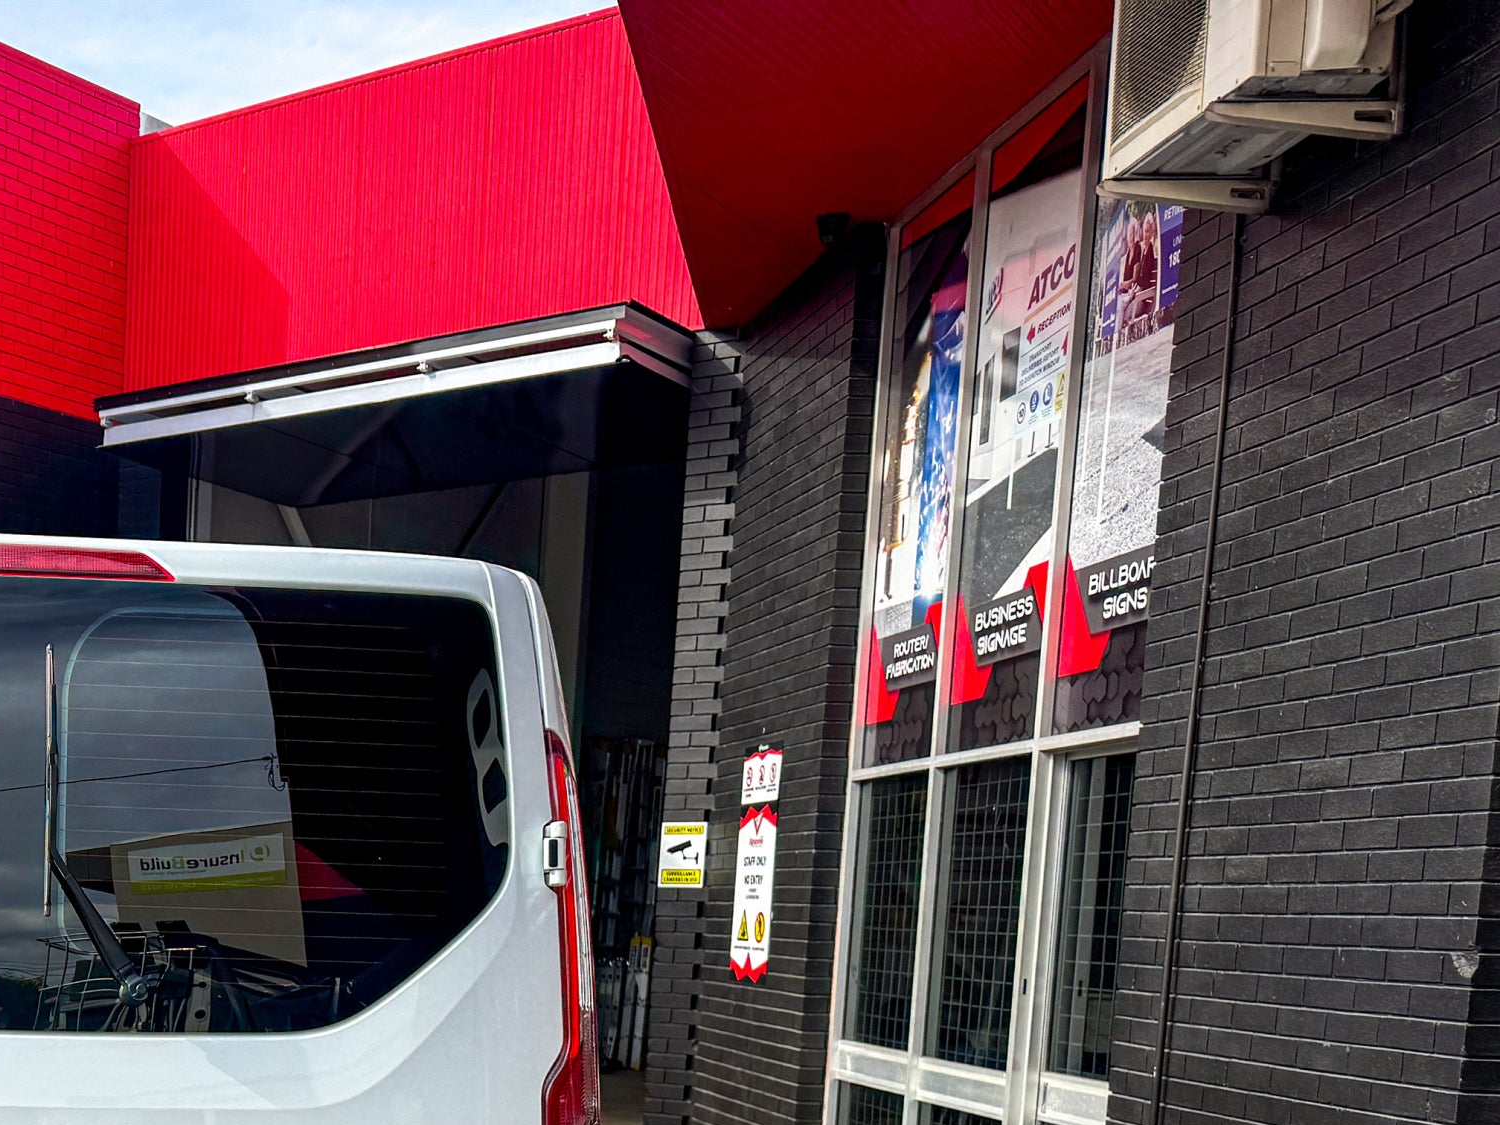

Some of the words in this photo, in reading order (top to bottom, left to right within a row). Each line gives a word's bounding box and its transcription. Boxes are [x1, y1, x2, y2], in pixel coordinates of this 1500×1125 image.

[1027, 243, 1077, 311] ATCO
[1037, 300, 1072, 334] RECEPTION
[974, 595, 1034, 633] BUSINESS
[1102, 587, 1149, 619] SIGNS
[977, 623, 1028, 656] SIGNAGE
[885, 652, 935, 680] FABRICATION
